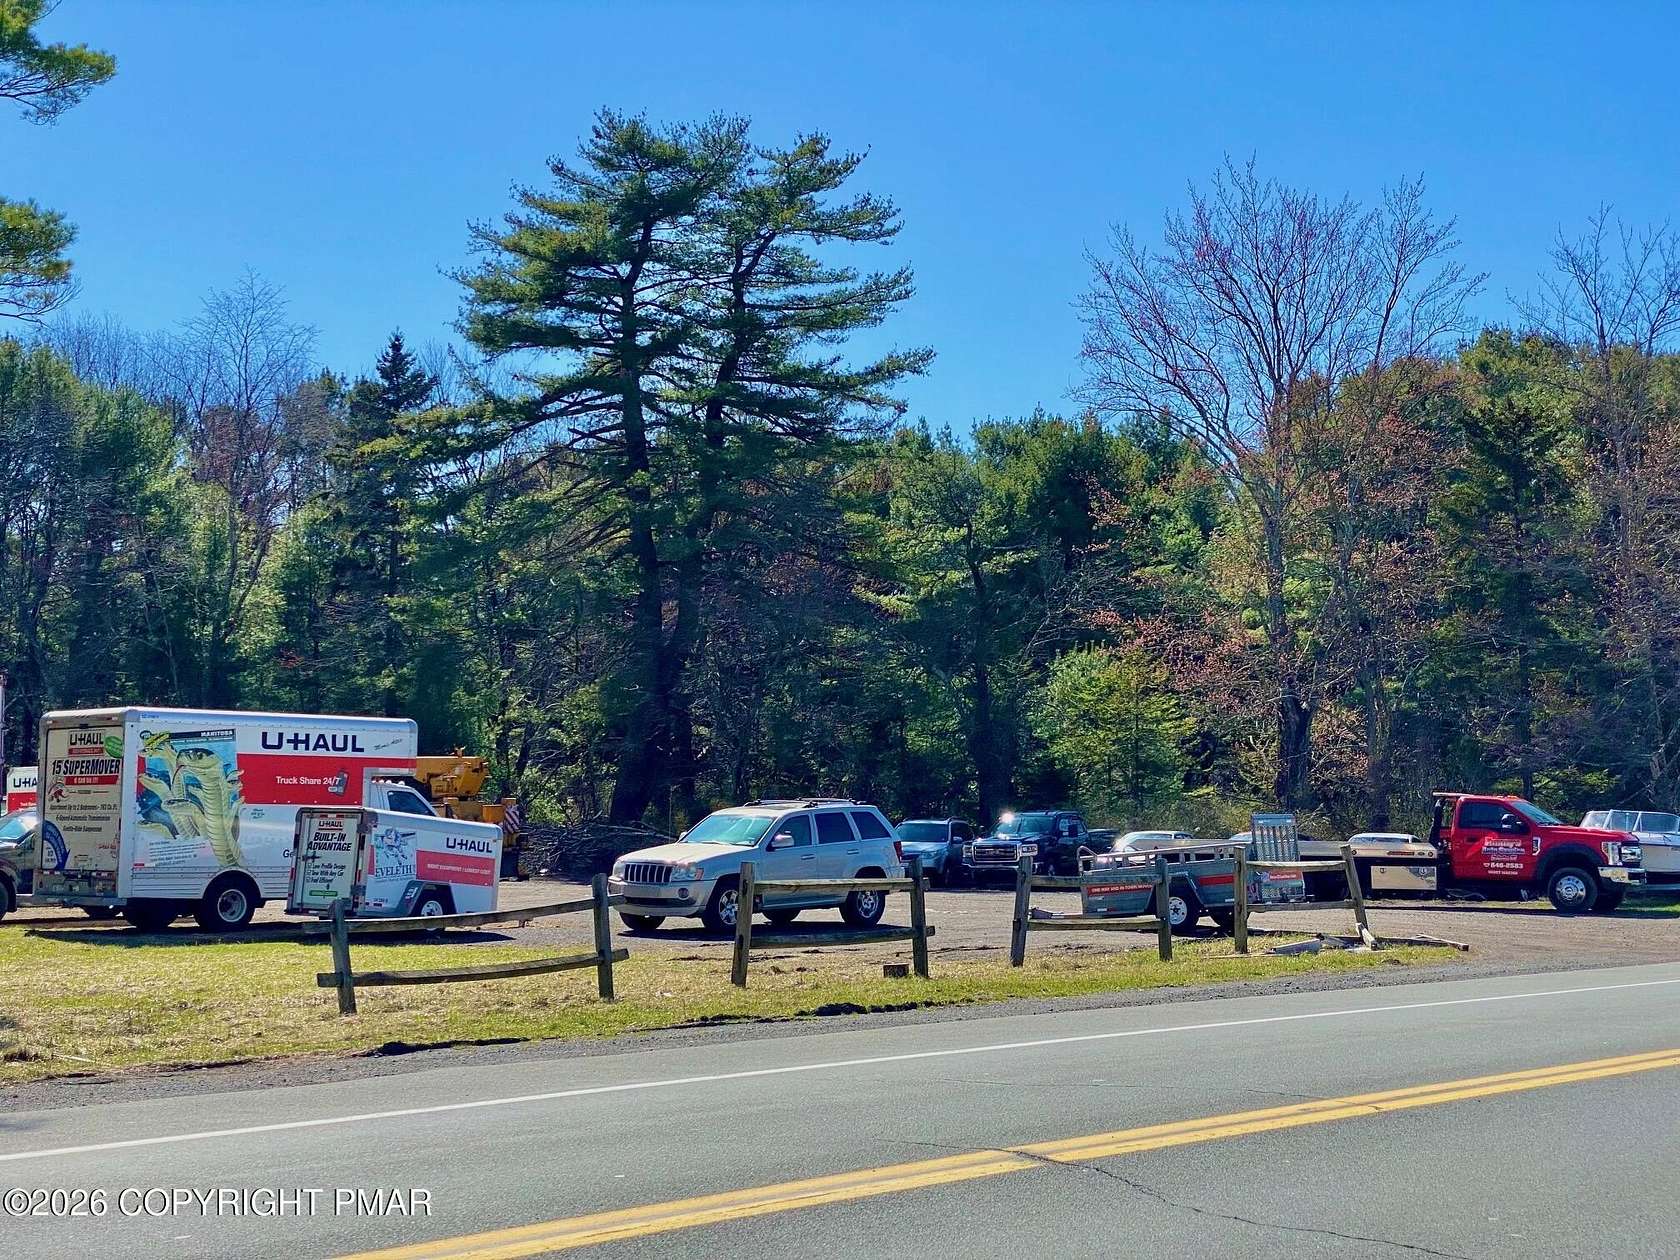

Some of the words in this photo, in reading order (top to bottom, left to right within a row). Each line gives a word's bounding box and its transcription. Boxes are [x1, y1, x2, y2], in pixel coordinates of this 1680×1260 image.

[70, 732, 104, 745] U-HAUL
[262, 732, 364, 752] U-HAUL
[14, 778, 38, 788] U-HA
[276, 776, 298, 784] Truck
[300, 776, 322, 785] Share
[323, 776, 341, 785] 24/7
[314, 832, 346, 841] BUILT-IN
[307, 841, 352, 851] ADVANTAGE
[446, 838, 492, 853] U-HAUL
[375, 865, 412, 877] EVELETH
